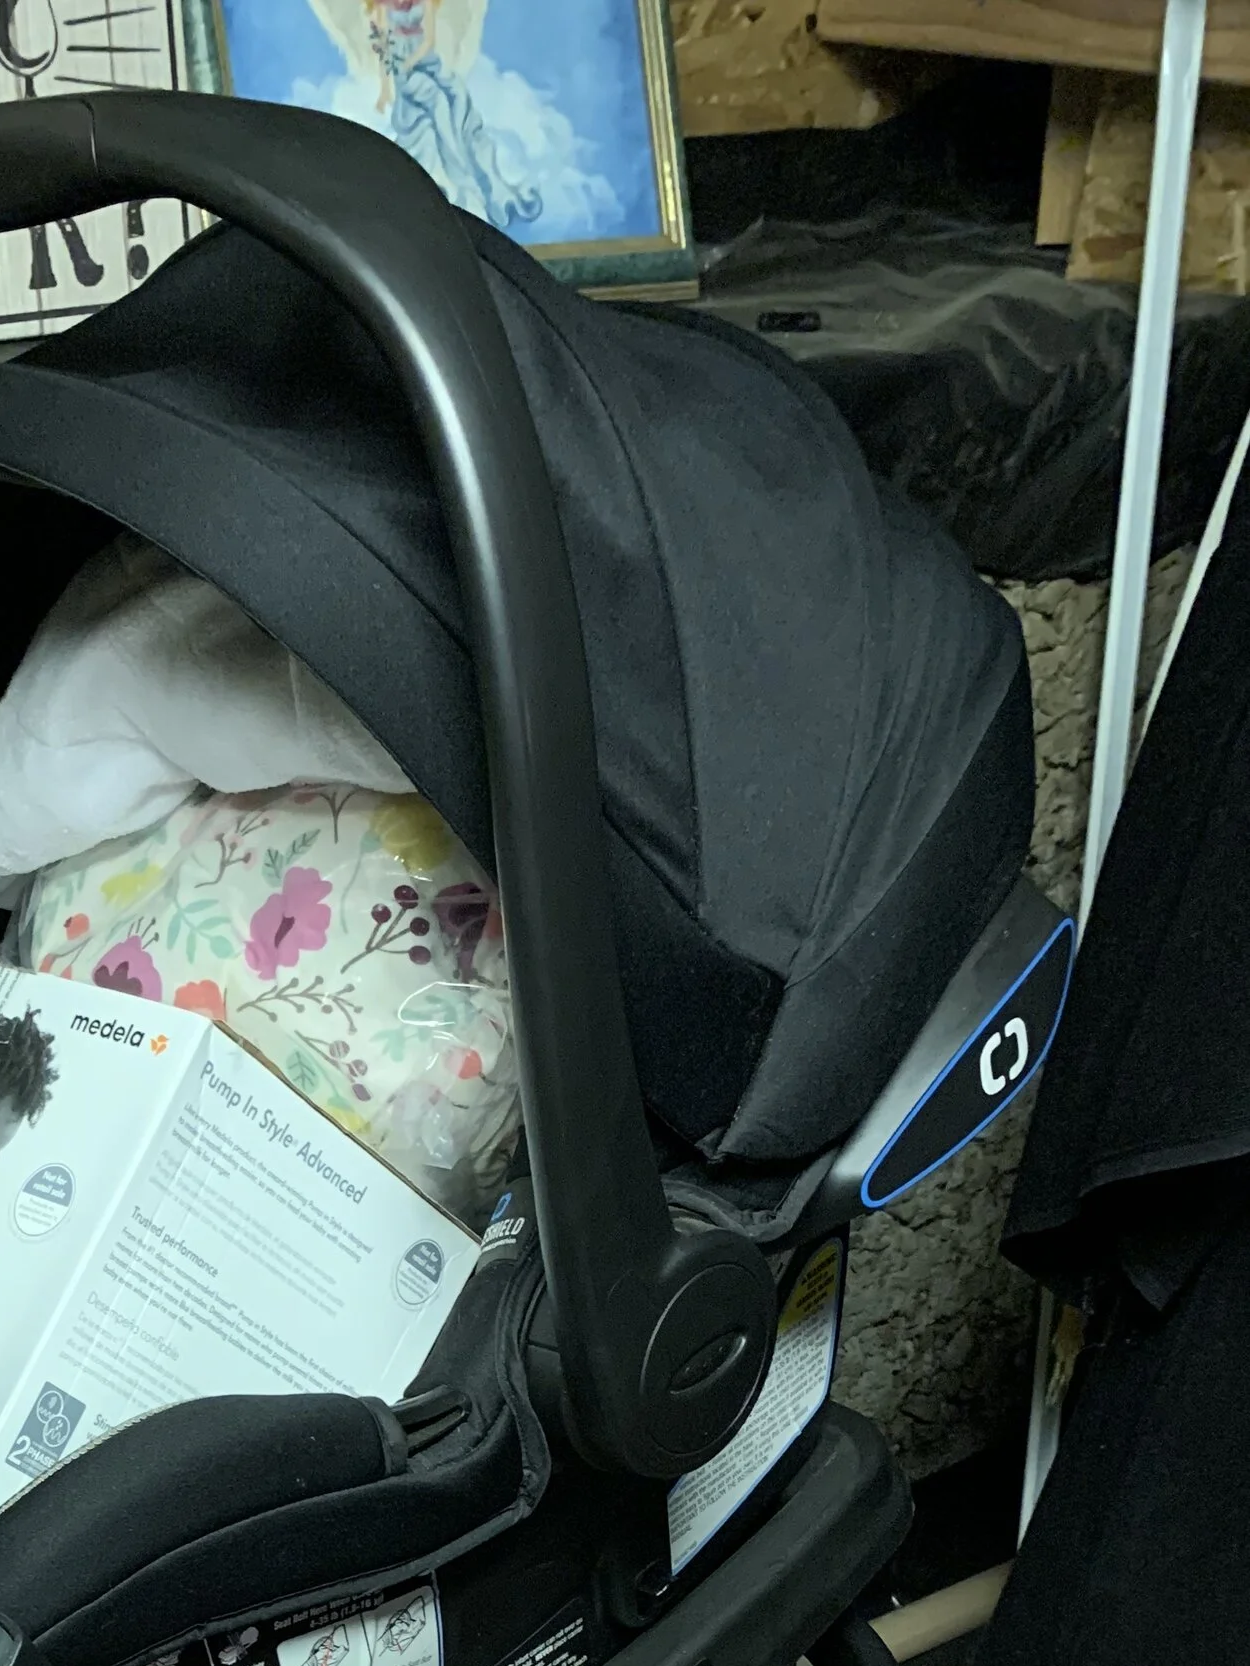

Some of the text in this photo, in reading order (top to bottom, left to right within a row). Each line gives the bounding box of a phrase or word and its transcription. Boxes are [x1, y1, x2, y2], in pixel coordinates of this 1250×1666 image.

[71, 1015, 143, 1046] medela
[199, 1060, 241, 1108] Pump
[243, 1095, 260, 1121] In
[296, 1142, 367, 1204] Advanced
[131, 1206, 220, 1278] Trusted performance
[6, 1434, 31, 1466] 2
[26, 1445, 56, 1469] PHASE
